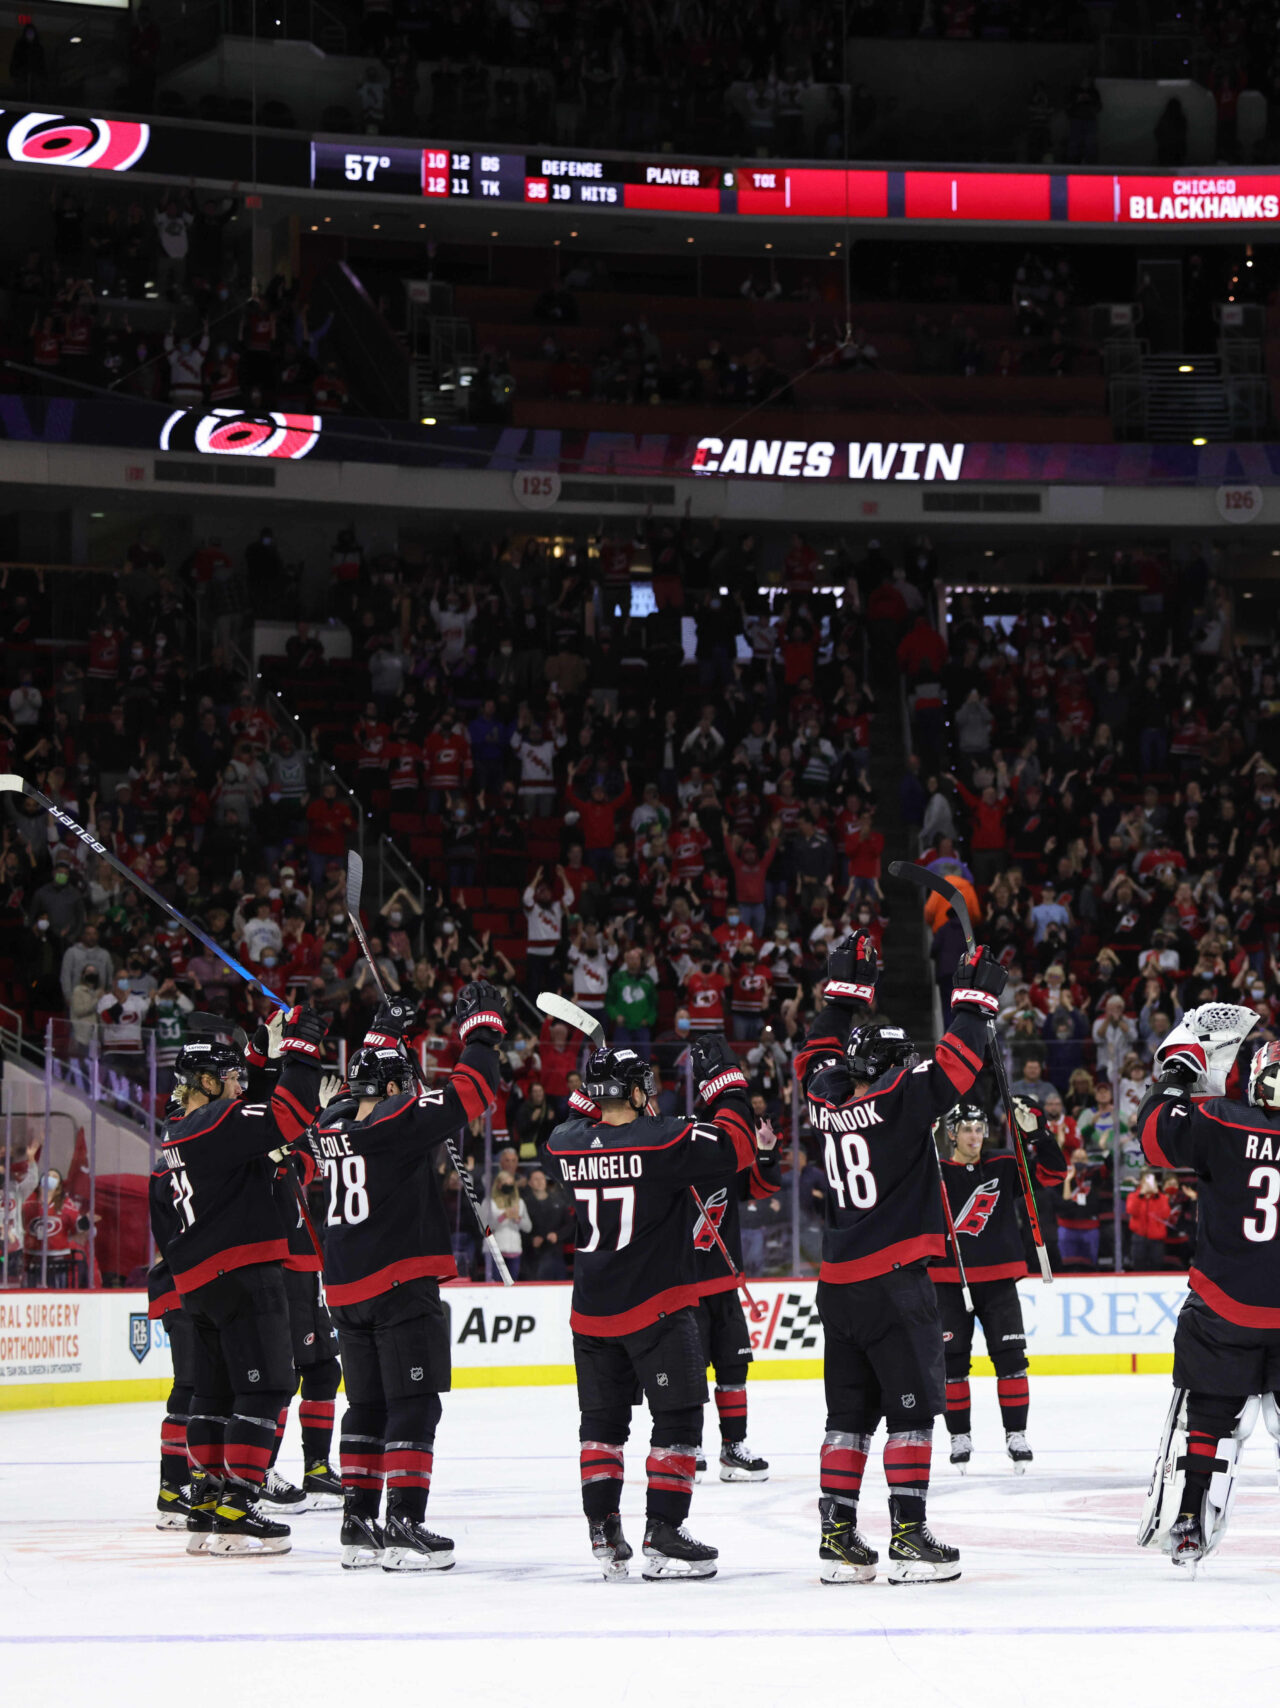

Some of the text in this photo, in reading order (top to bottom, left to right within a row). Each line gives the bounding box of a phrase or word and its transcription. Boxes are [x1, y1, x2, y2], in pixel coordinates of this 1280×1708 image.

[345, 153, 391, 182] 57°
[428, 153, 500, 172] 10 12 BS
[542, 159, 603, 178] DEFENSE
[427, 178, 500, 197] 12 11 TK
[646, 167, 700, 186] PLAYER
[1173, 179, 1236, 195] CHICAGO
[552, 184, 571, 200] 19
[580, 186, 617, 203] HITS
[1129, 195, 1279, 219] BLACKHAWKS
[691, 437, 964, 480] CANES WIN
[522, 477, 553, 495] 125
[49, 805, 107, 854] BAUER
[824, 980, 873, 999] CCM
[952, 988, 999, 1010] CCM
[350, 1065, 360, 1078] 28
[593, 1084, 604, 1096] 77
[320, 1133, 353, 1157] COLE
[824, 1132, 878, 1210] 48
[322, 1154, 370, 1228] 28
[573, 1185, 636, 1254] 77
[26, 1303, 80, 1329] SURGERY
[1057, 1290, 1187, 1338] REX
[0, 1334, 80, 1361] ORTHODONTICS
[894, 1541, 922, 1559] CCM
